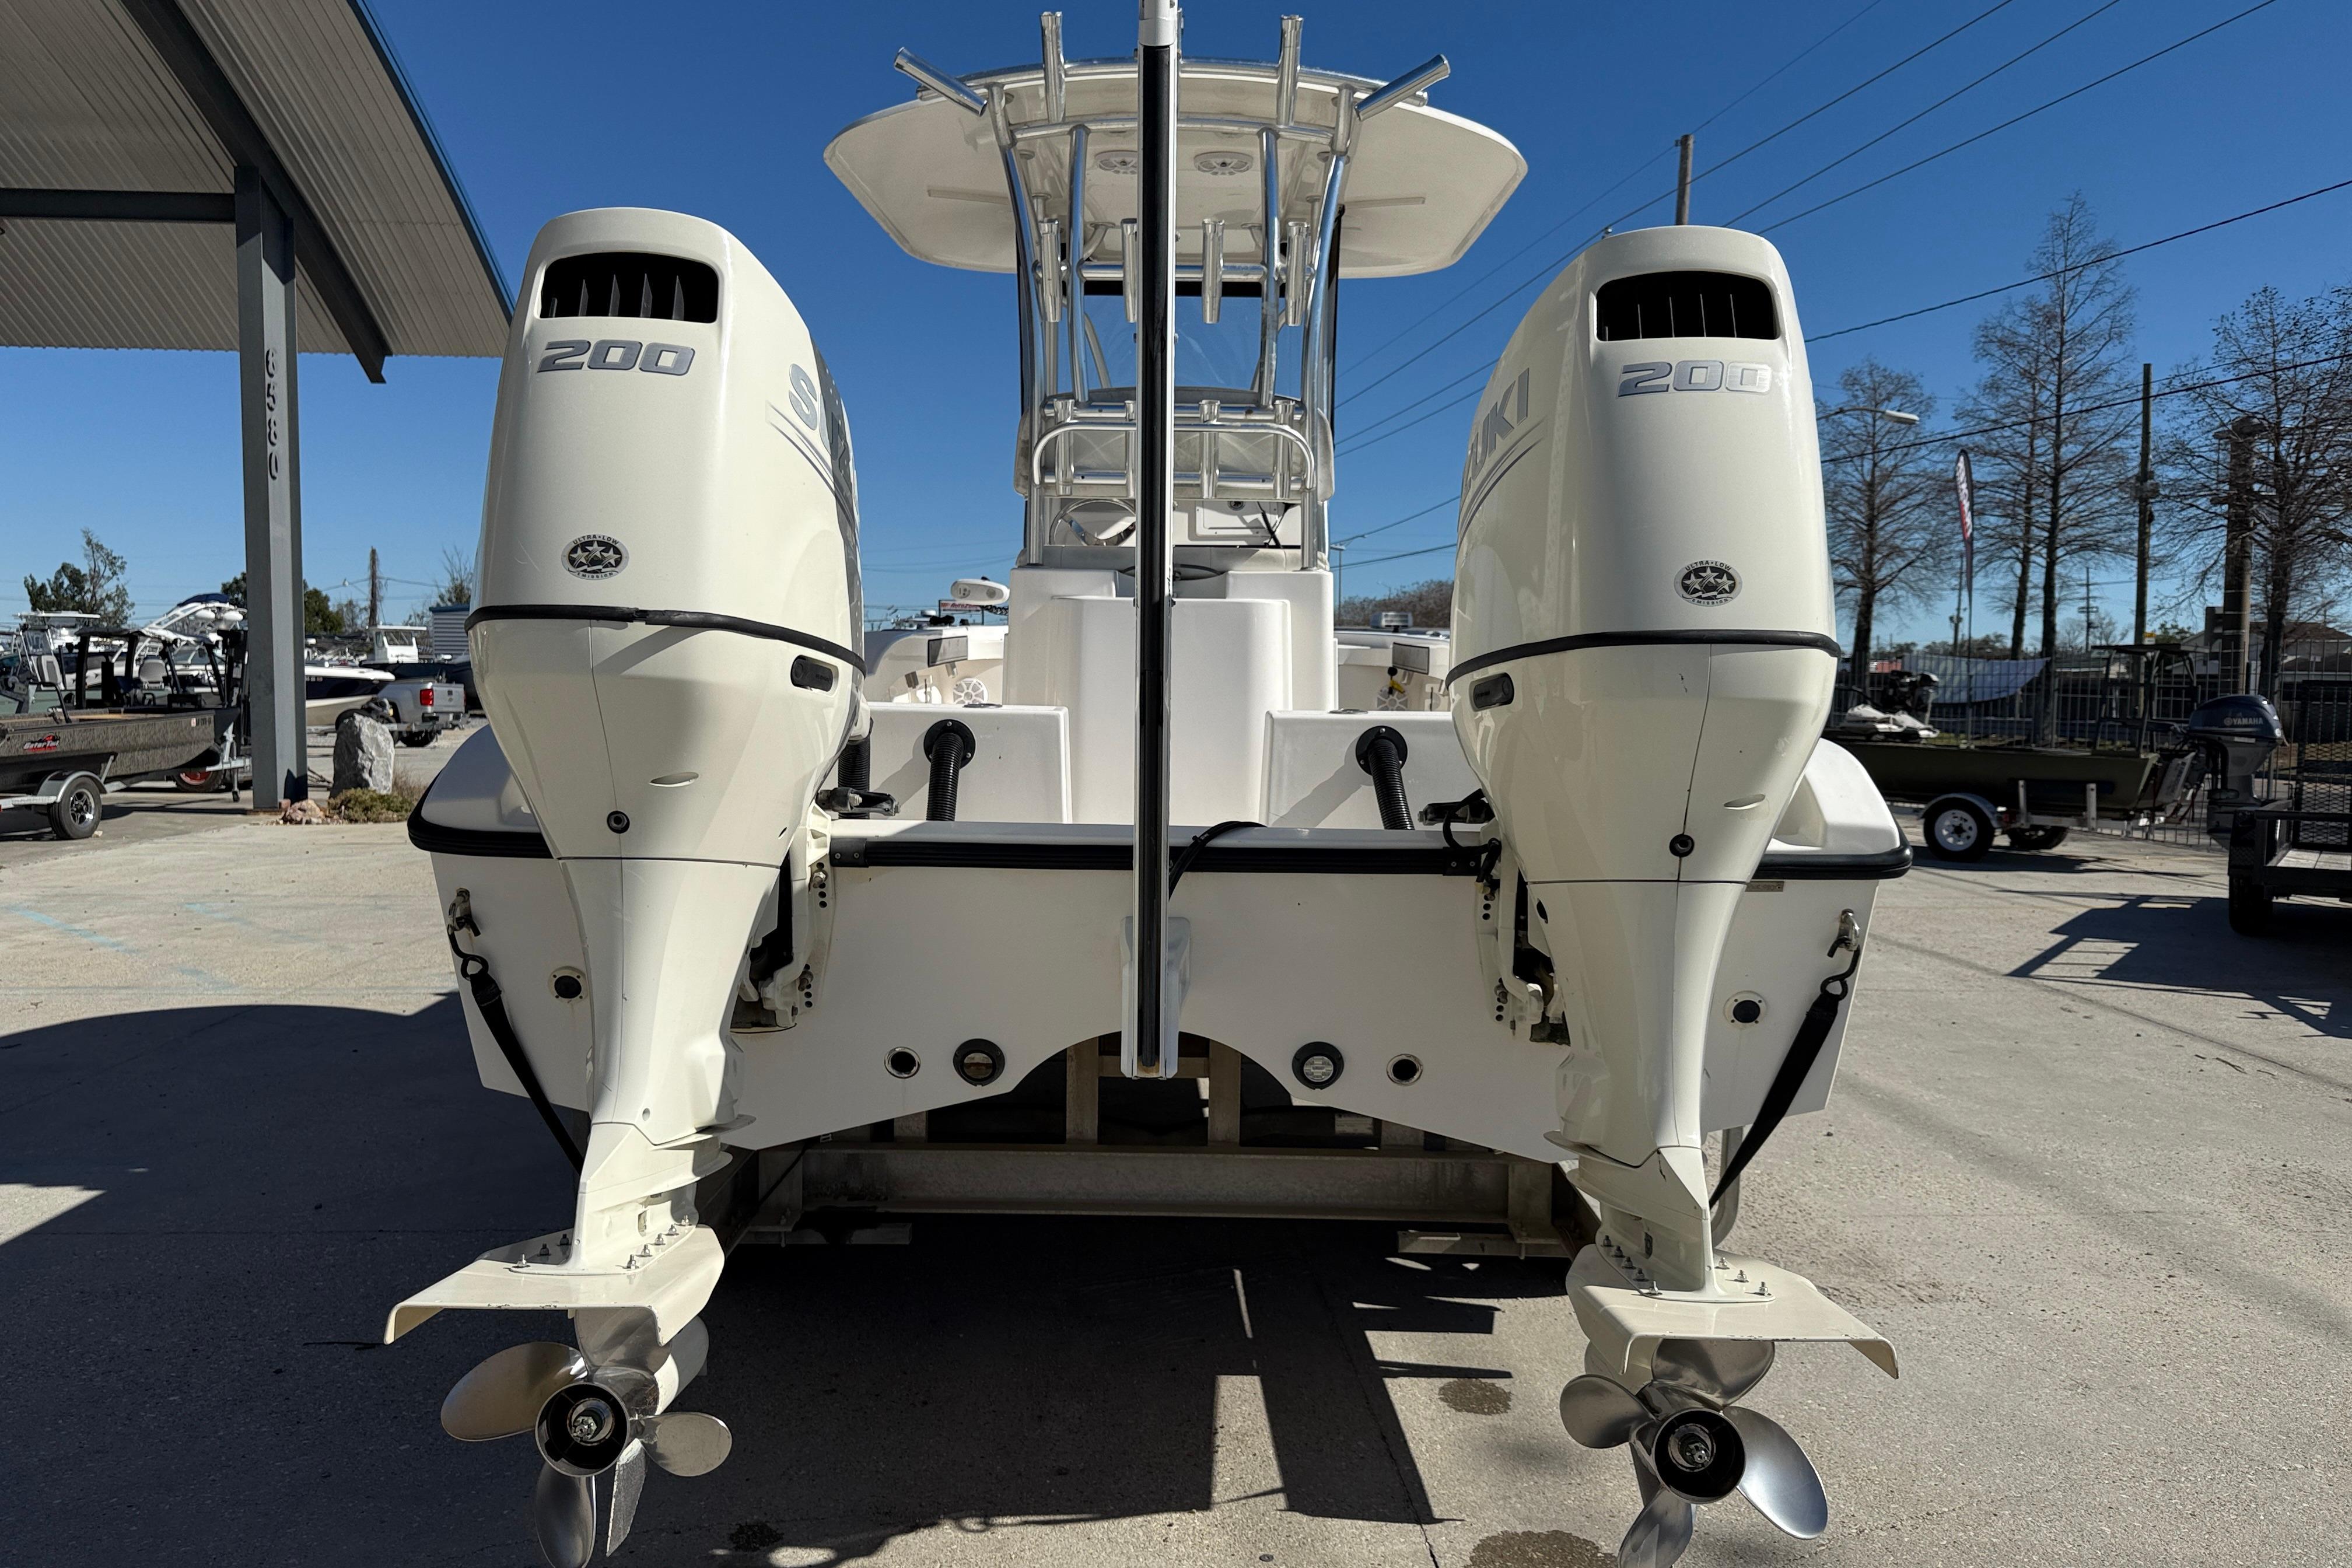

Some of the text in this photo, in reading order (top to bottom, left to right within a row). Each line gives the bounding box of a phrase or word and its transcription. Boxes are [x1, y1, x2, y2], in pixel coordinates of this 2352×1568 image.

[537, 340, 695, 376] 200
[1618, 360, 1772, 397] 200
[573, 534, 619, 545] ULTRA LOW
[1685, 561, 1732, 571] ULTRA LOW
